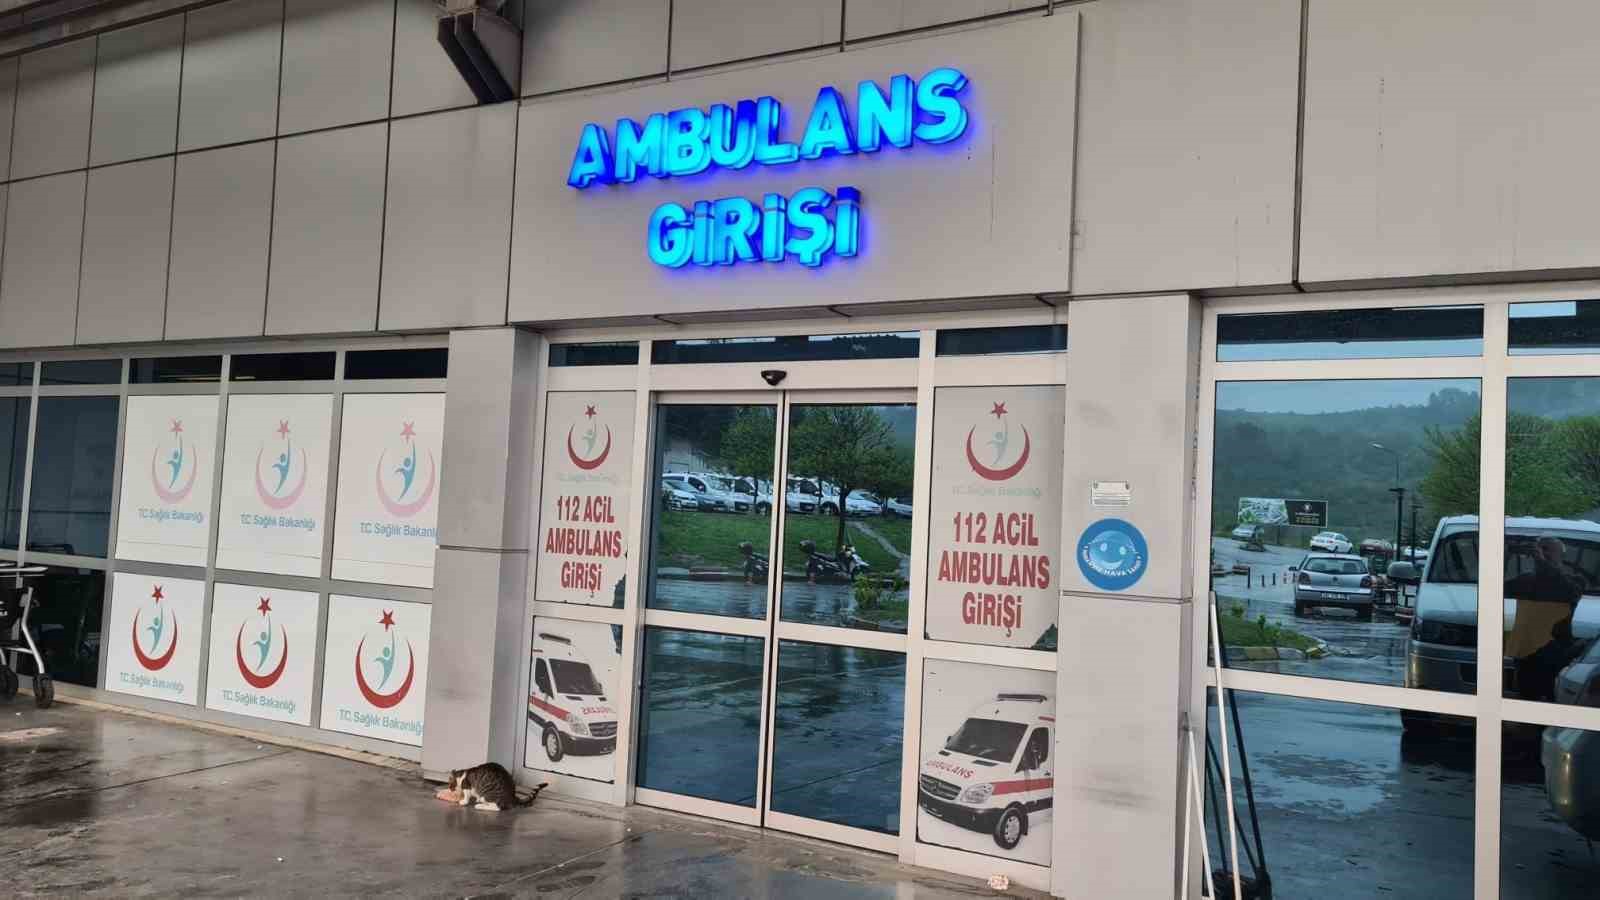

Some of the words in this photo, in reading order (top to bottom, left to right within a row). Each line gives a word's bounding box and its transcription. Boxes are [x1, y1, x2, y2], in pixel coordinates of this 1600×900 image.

[567, 67, 969, 188] AMBULANS
[557, 495, 581, 521] 112
[545, 527, 622, 558] AMBULANS
[953, 511, 987, 544] 112
[938, 550, 1050, 589] AMBULANS
